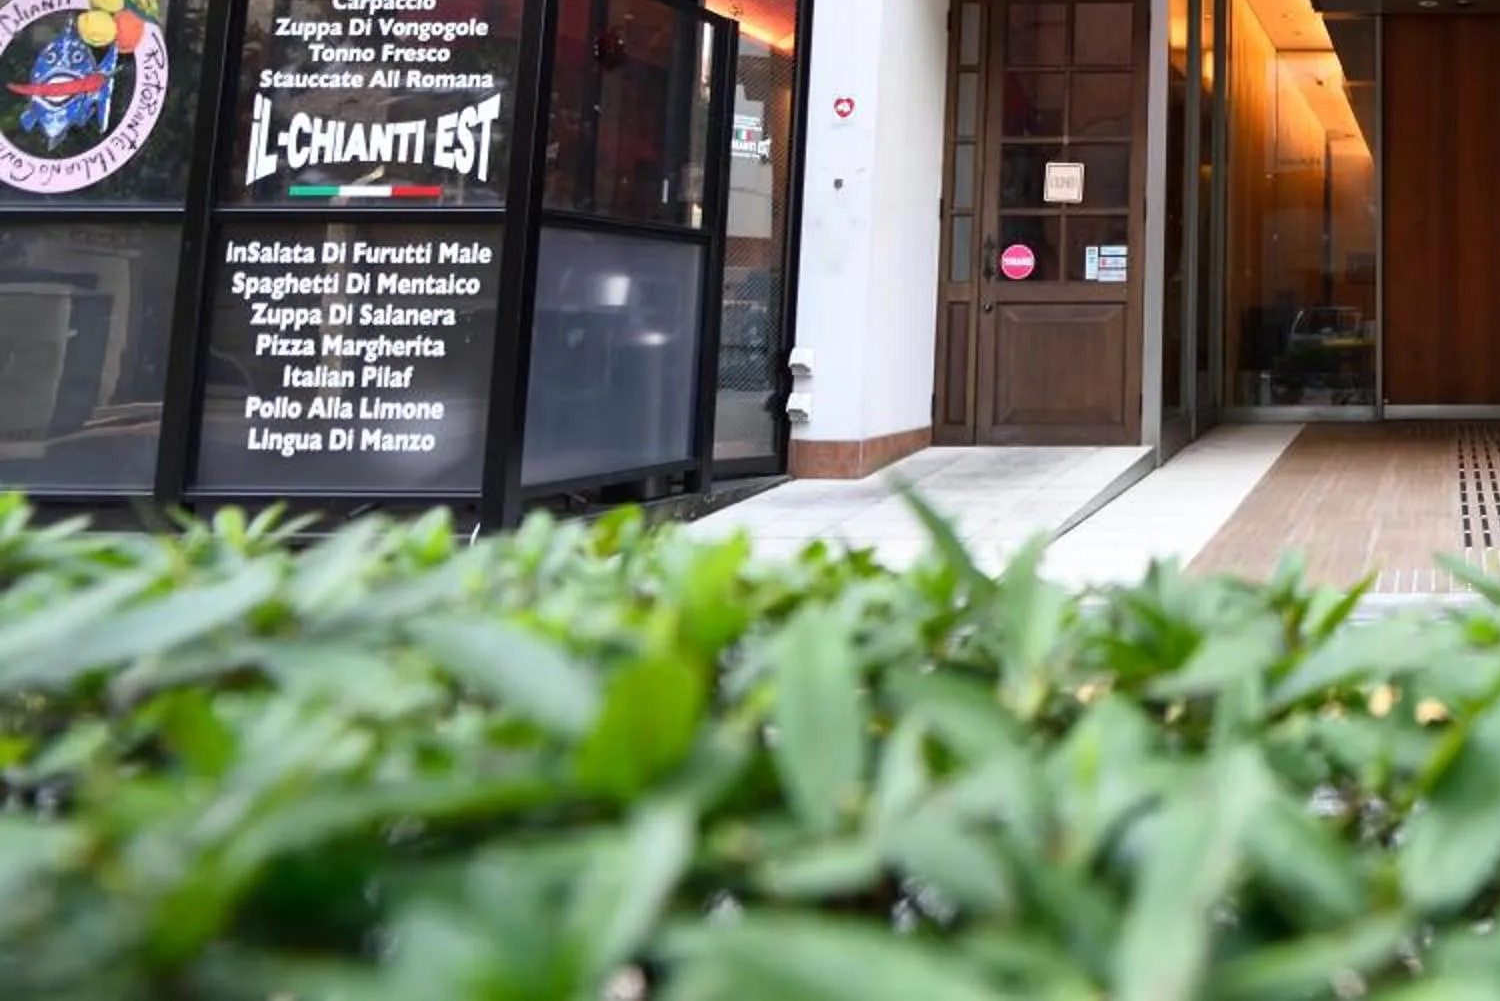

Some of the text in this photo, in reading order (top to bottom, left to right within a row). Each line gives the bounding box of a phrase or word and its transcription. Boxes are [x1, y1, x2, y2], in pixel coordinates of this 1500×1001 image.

[275, 18, 489, 42] Zuppa Di Vongogole
[308, 43, 451, 63] Tonno Fresco
[259, 69, 365, 89] Stauccate
[405, 69, 495, 90] Romana
[433, 93, 501, 182] EST
[321, 241, 347, 264] Di
[352, 242, 432, 264] Furutti
[438, 242, 492, 264] Male
[231, 271, 340, 300] Spaghetti
[345, 272, 371, 294] Di
[250, 302, 456, 331] Zuppa Di Salanera
[255, 333, 446, 363] Pizza Margherita
[283, 364, 414, 388] Italian Pilaf
[245, 396, 445, 421] Pollo Alla Limone
[247, 427, 436, 457] Lingua Di Manzo
